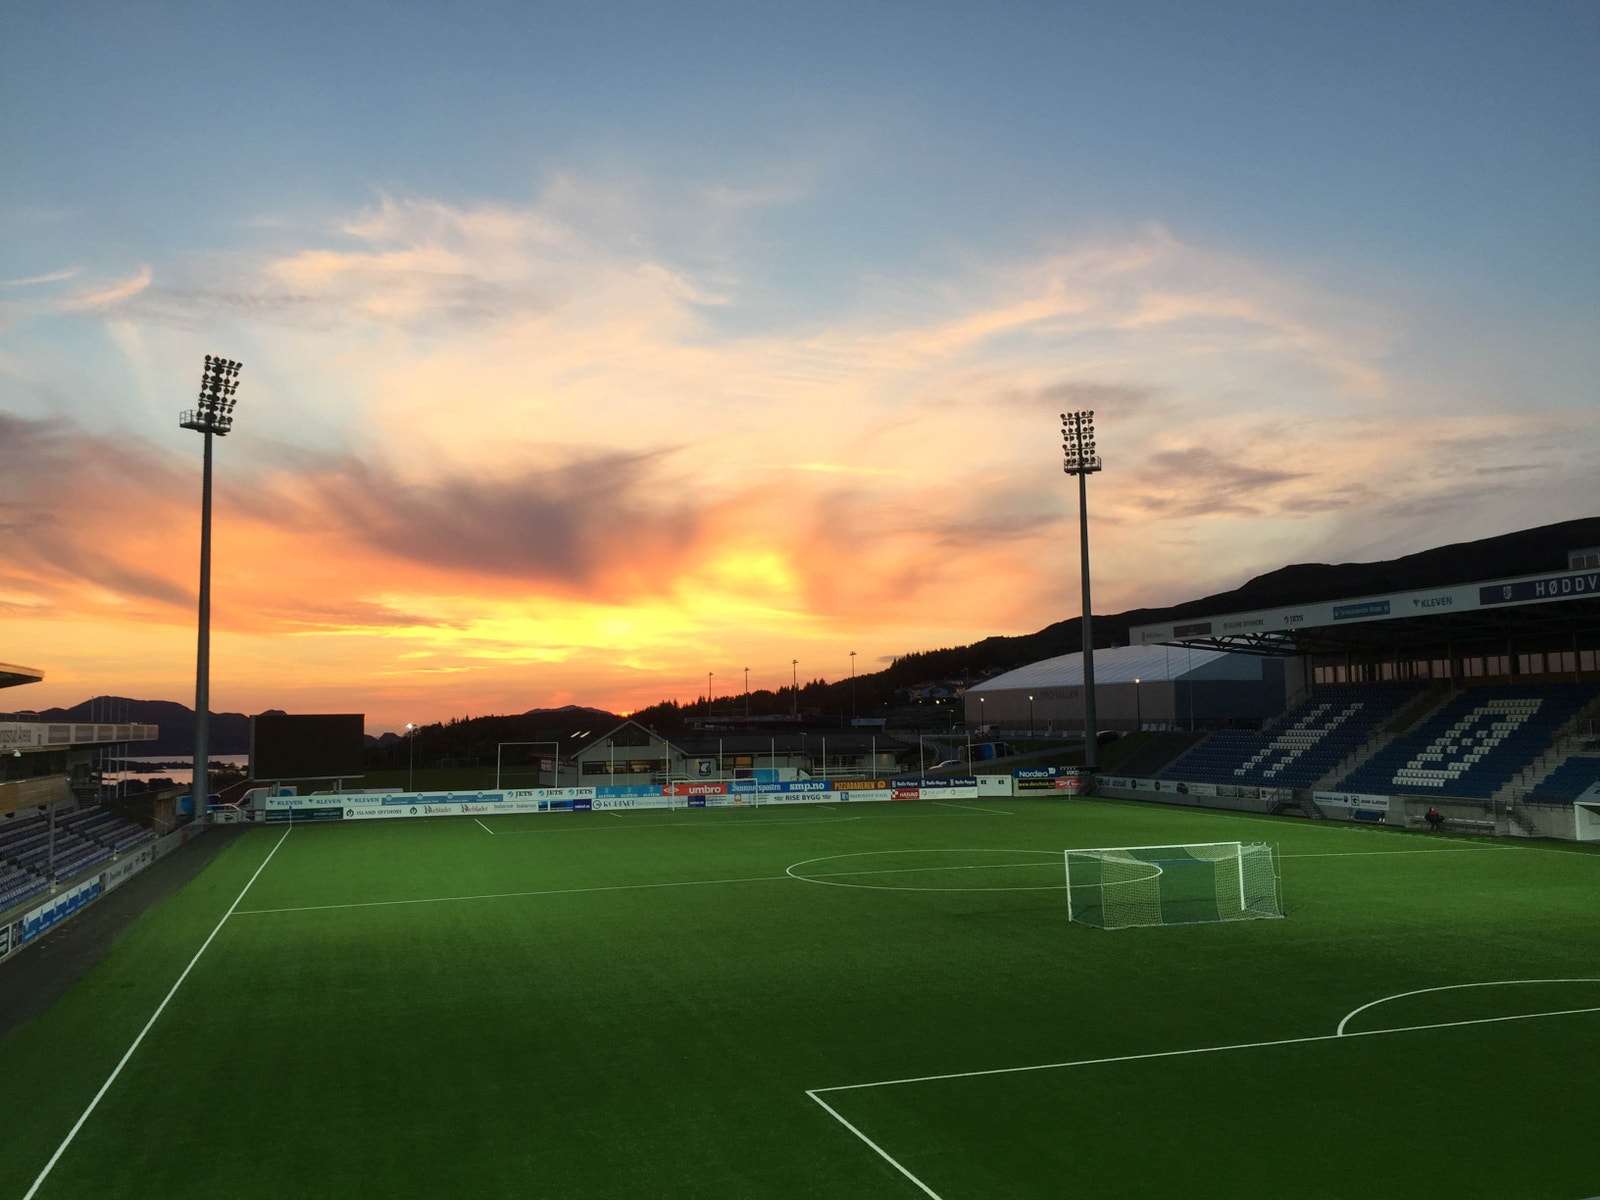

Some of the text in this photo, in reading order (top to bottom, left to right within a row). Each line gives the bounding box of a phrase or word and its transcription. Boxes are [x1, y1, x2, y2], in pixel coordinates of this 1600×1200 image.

[1420, 597, 1453, 608] KLEVEN
[1018, 769, 1048, 778] Nordea
[689, 786, 721, 794] umbro
[790, 782, 825, 791] smp.no
